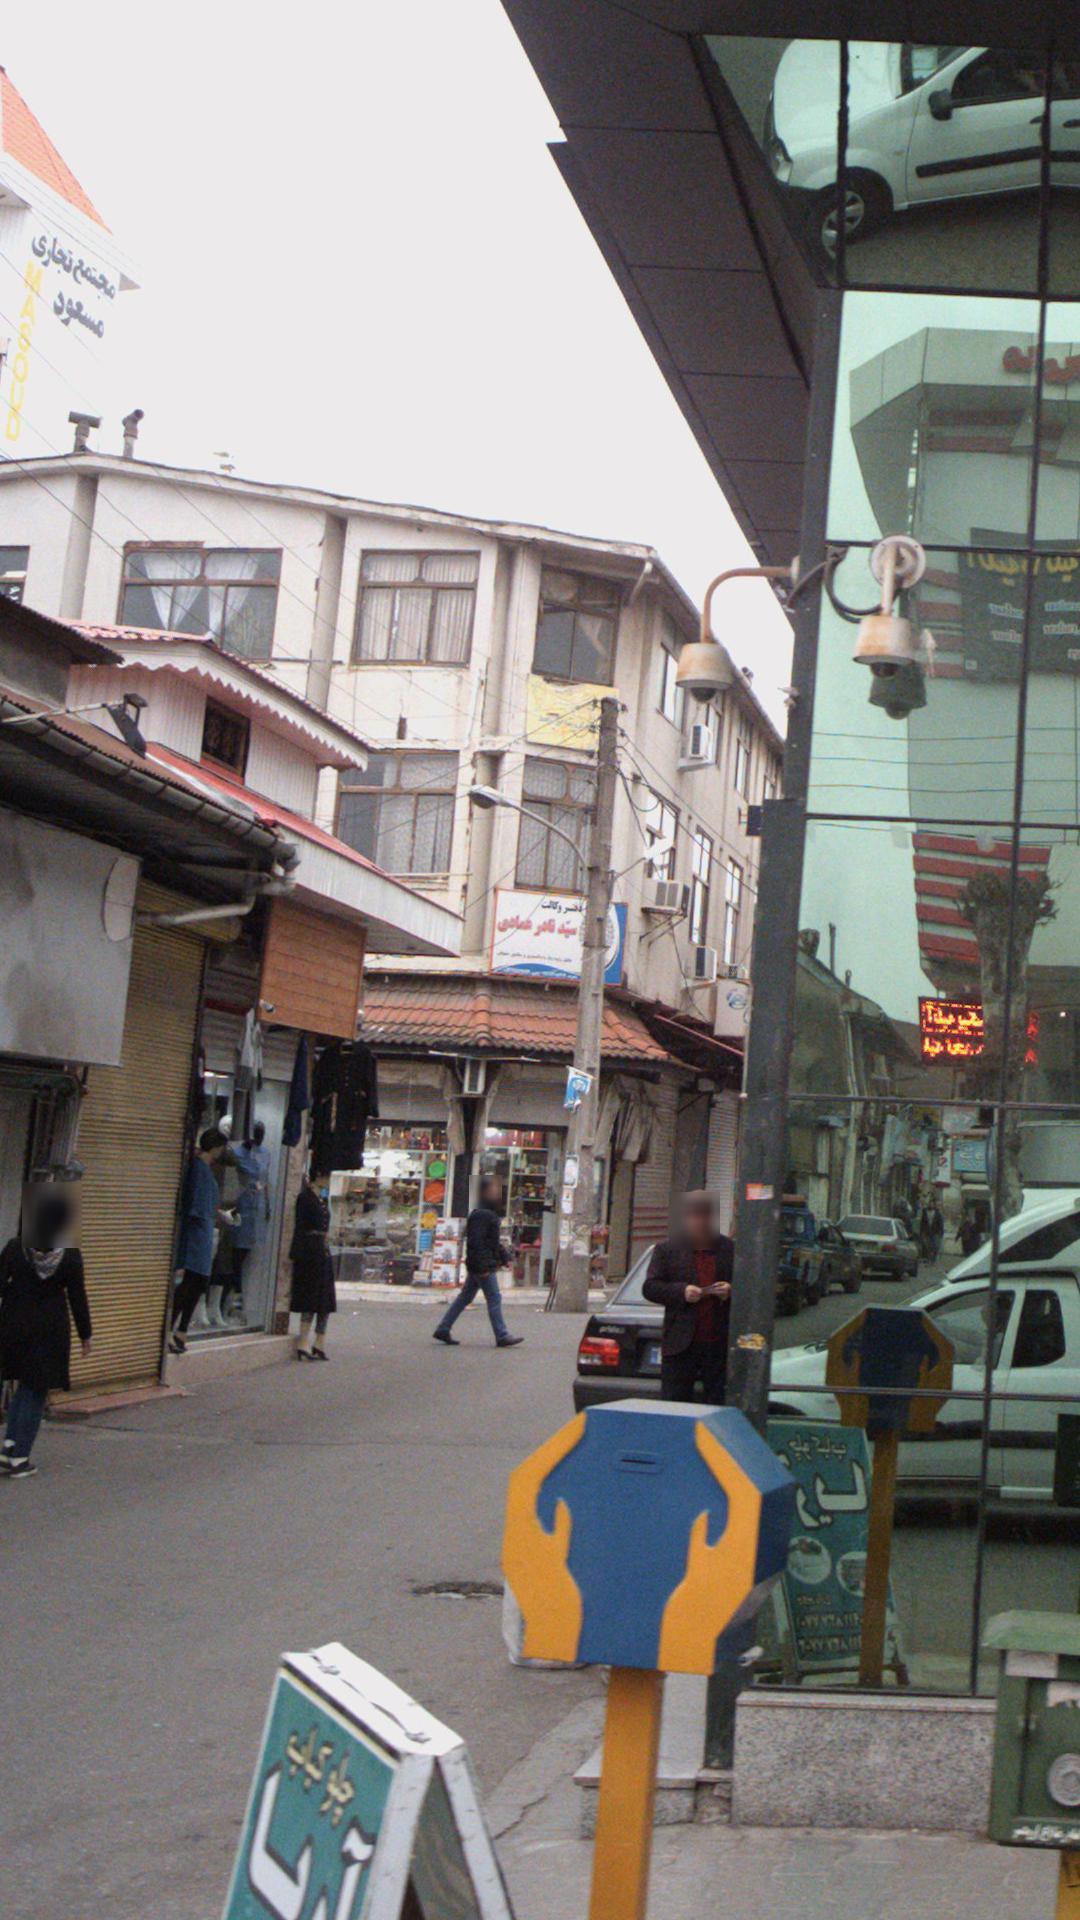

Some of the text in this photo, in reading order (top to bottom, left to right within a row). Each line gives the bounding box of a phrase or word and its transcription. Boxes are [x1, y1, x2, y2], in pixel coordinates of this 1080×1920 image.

[31, 233, 117, 300] مجتمع تجاری
[52, 290, 105, 339] مسعود
[541, 900, 562, 914] وکالت
